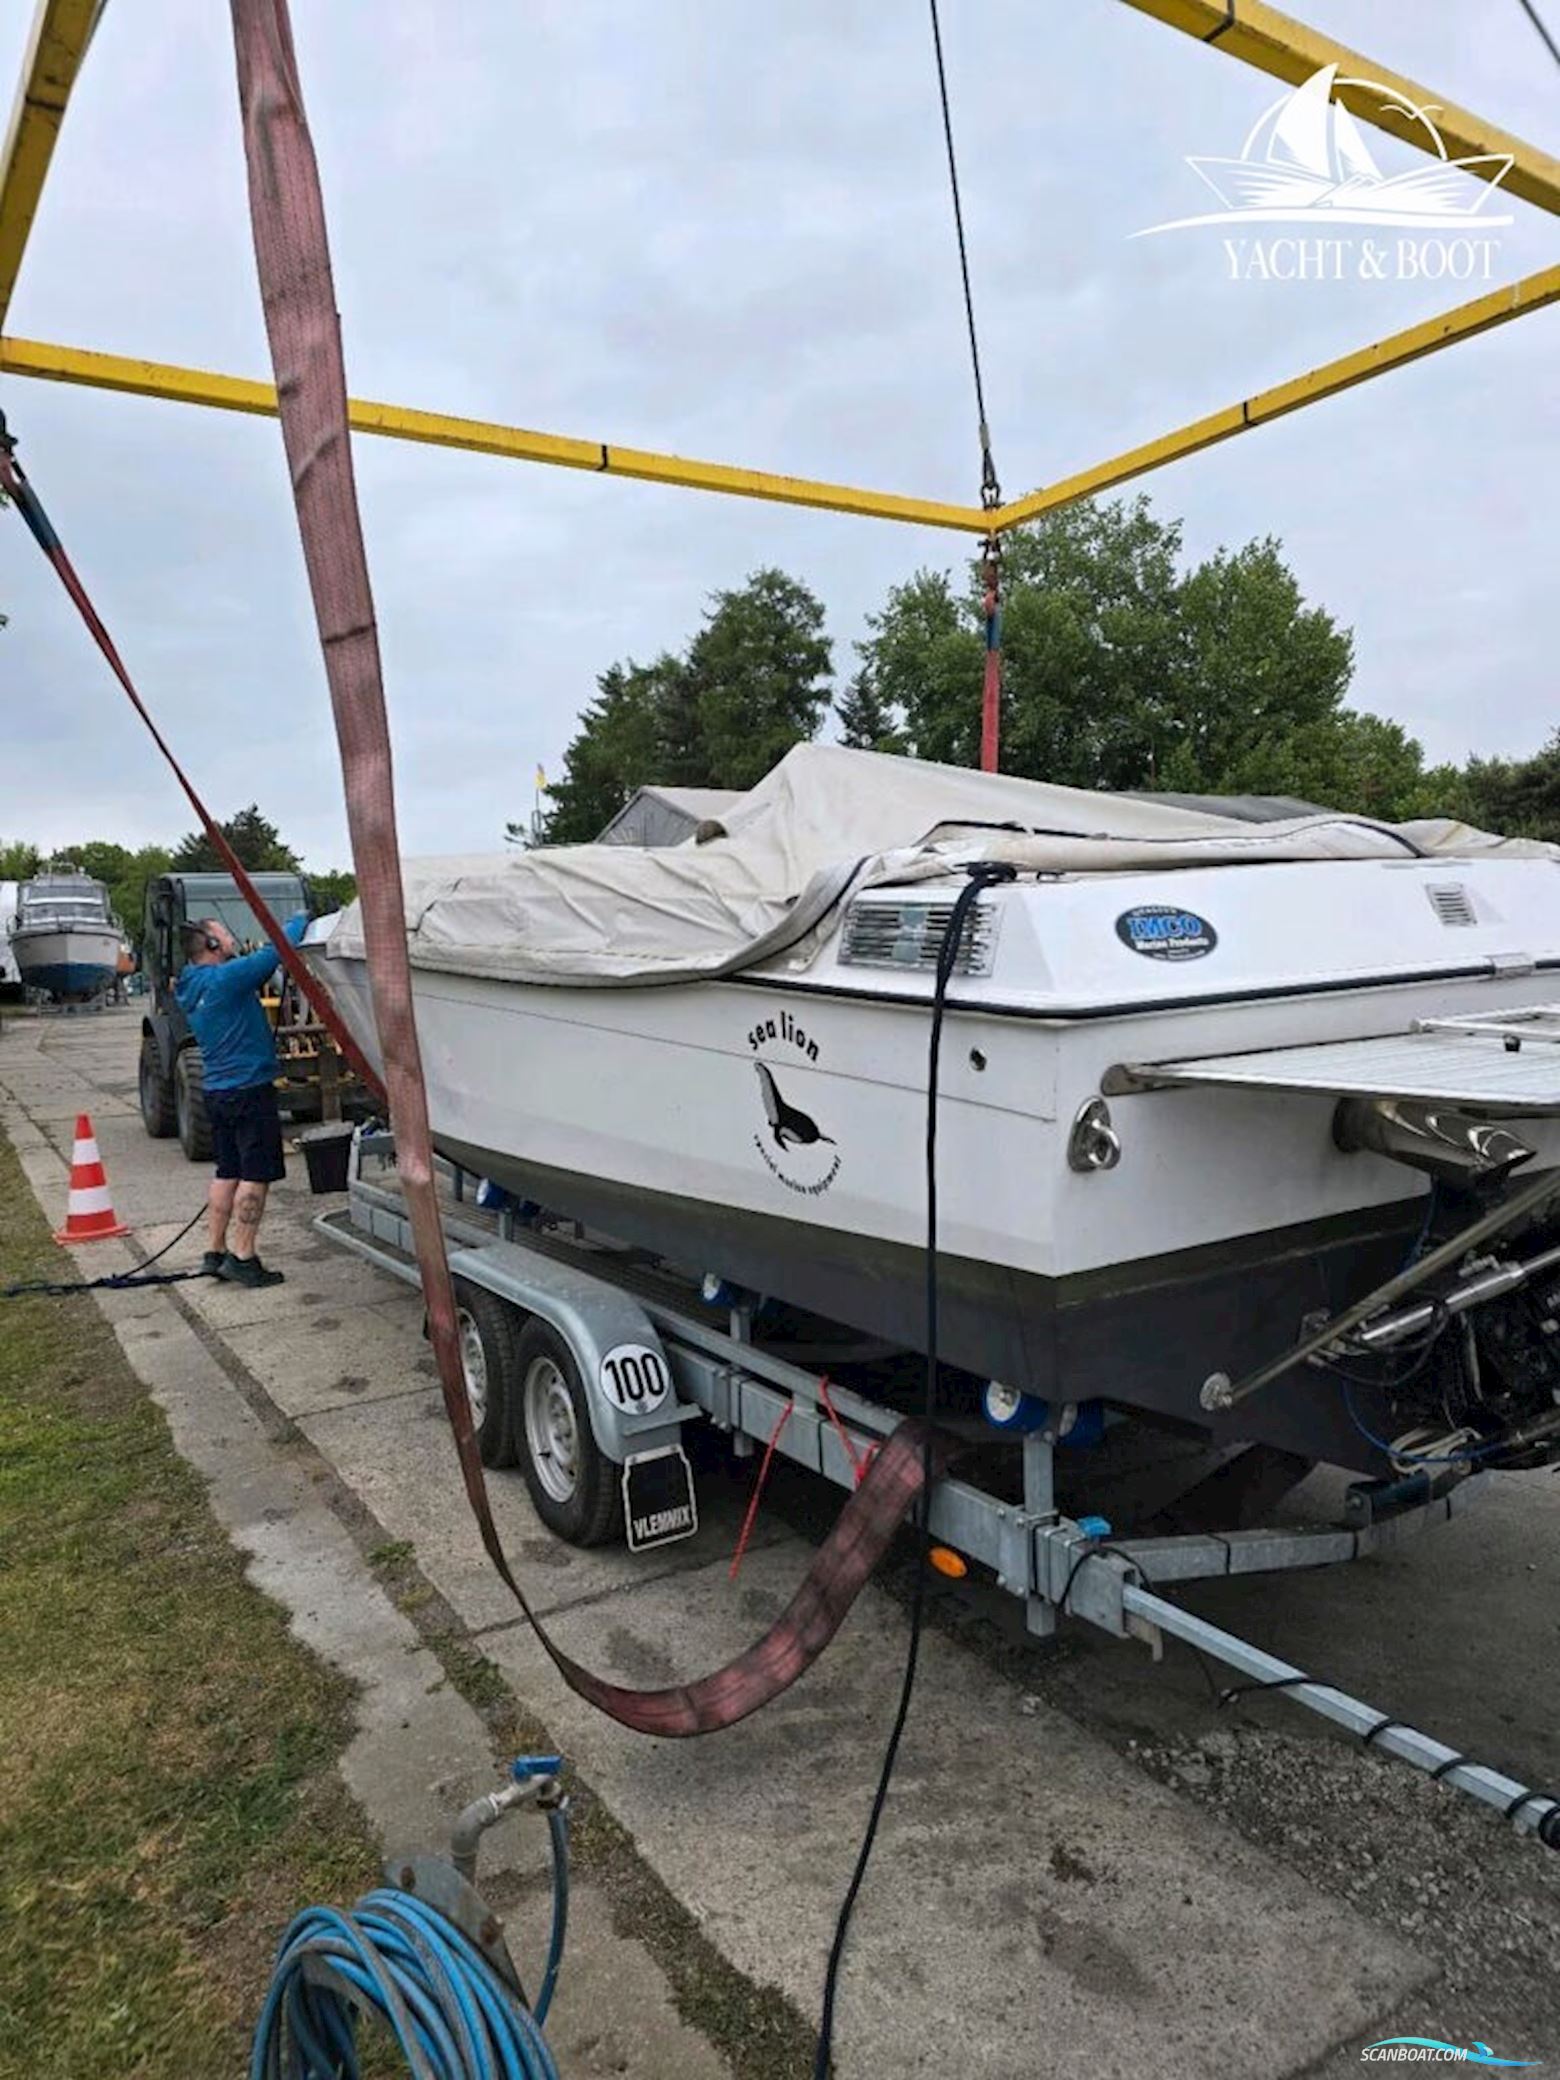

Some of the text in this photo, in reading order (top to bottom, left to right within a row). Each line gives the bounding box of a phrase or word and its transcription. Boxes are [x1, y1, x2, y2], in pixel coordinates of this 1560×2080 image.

[748, 1010, 819, 1062] sea lion
[605, 1353, 665, 1404] 100
[633, 1504, 692, 1540] VLEMMIX
